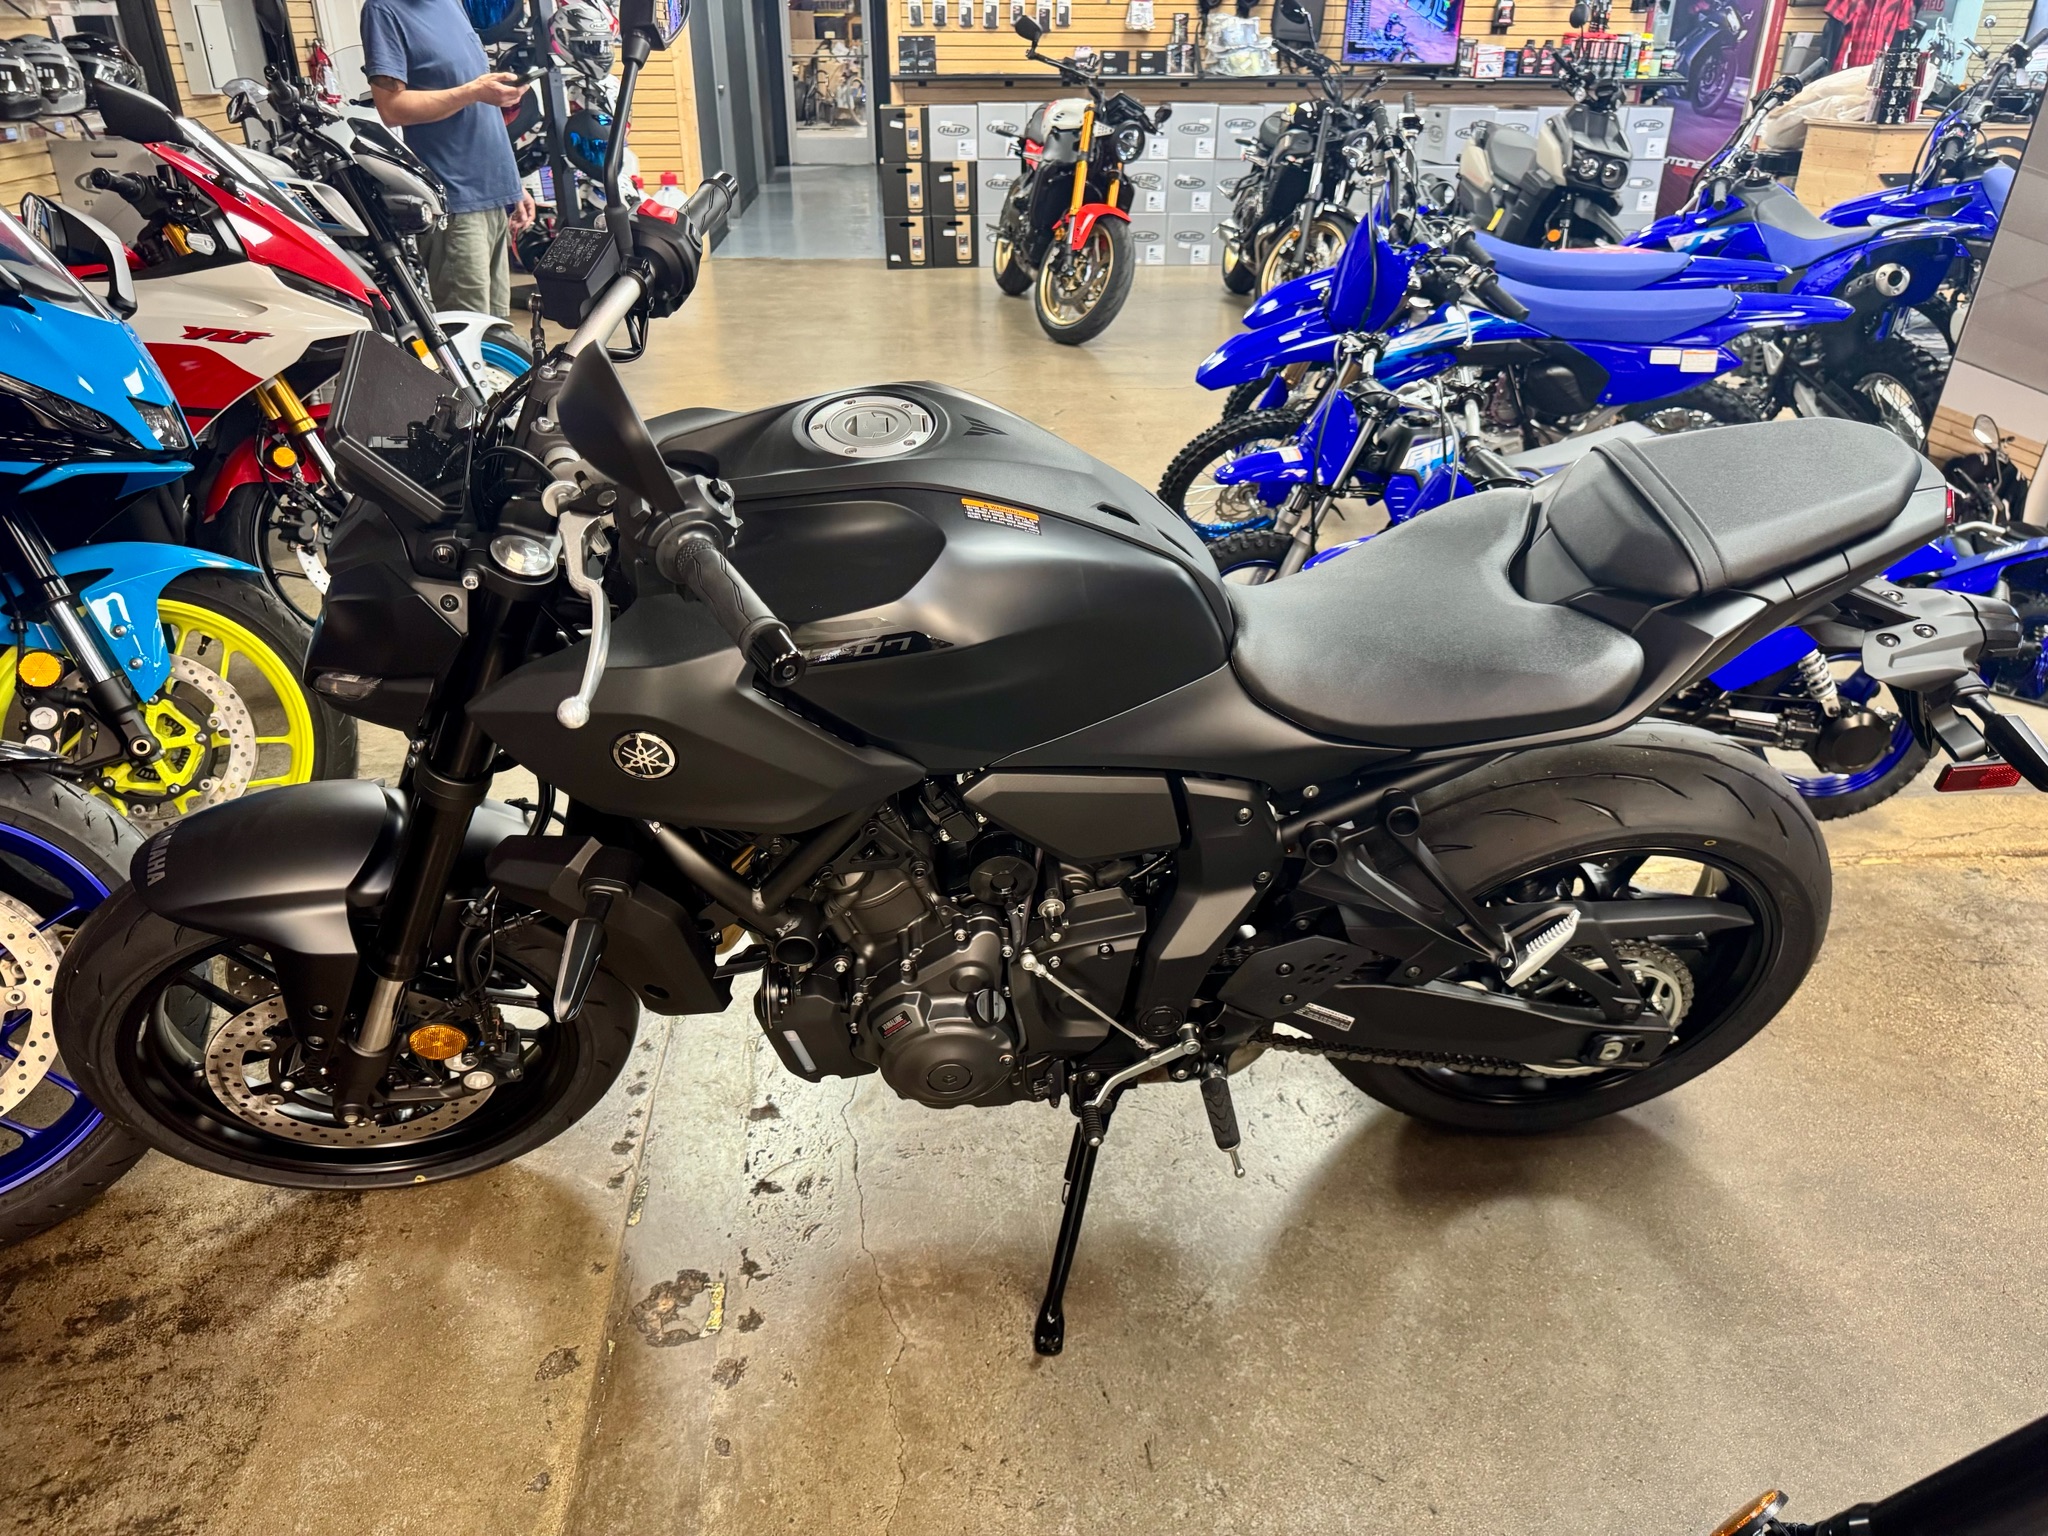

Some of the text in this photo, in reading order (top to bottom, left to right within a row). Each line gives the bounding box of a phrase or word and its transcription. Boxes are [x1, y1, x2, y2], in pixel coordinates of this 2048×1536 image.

[941, 126, 966, 134] HJC
[1182, 125, 1206, 133] HJC
[1178, 179, 1202, 187] HJC
[1178, 232, 1202, 240] HJC
